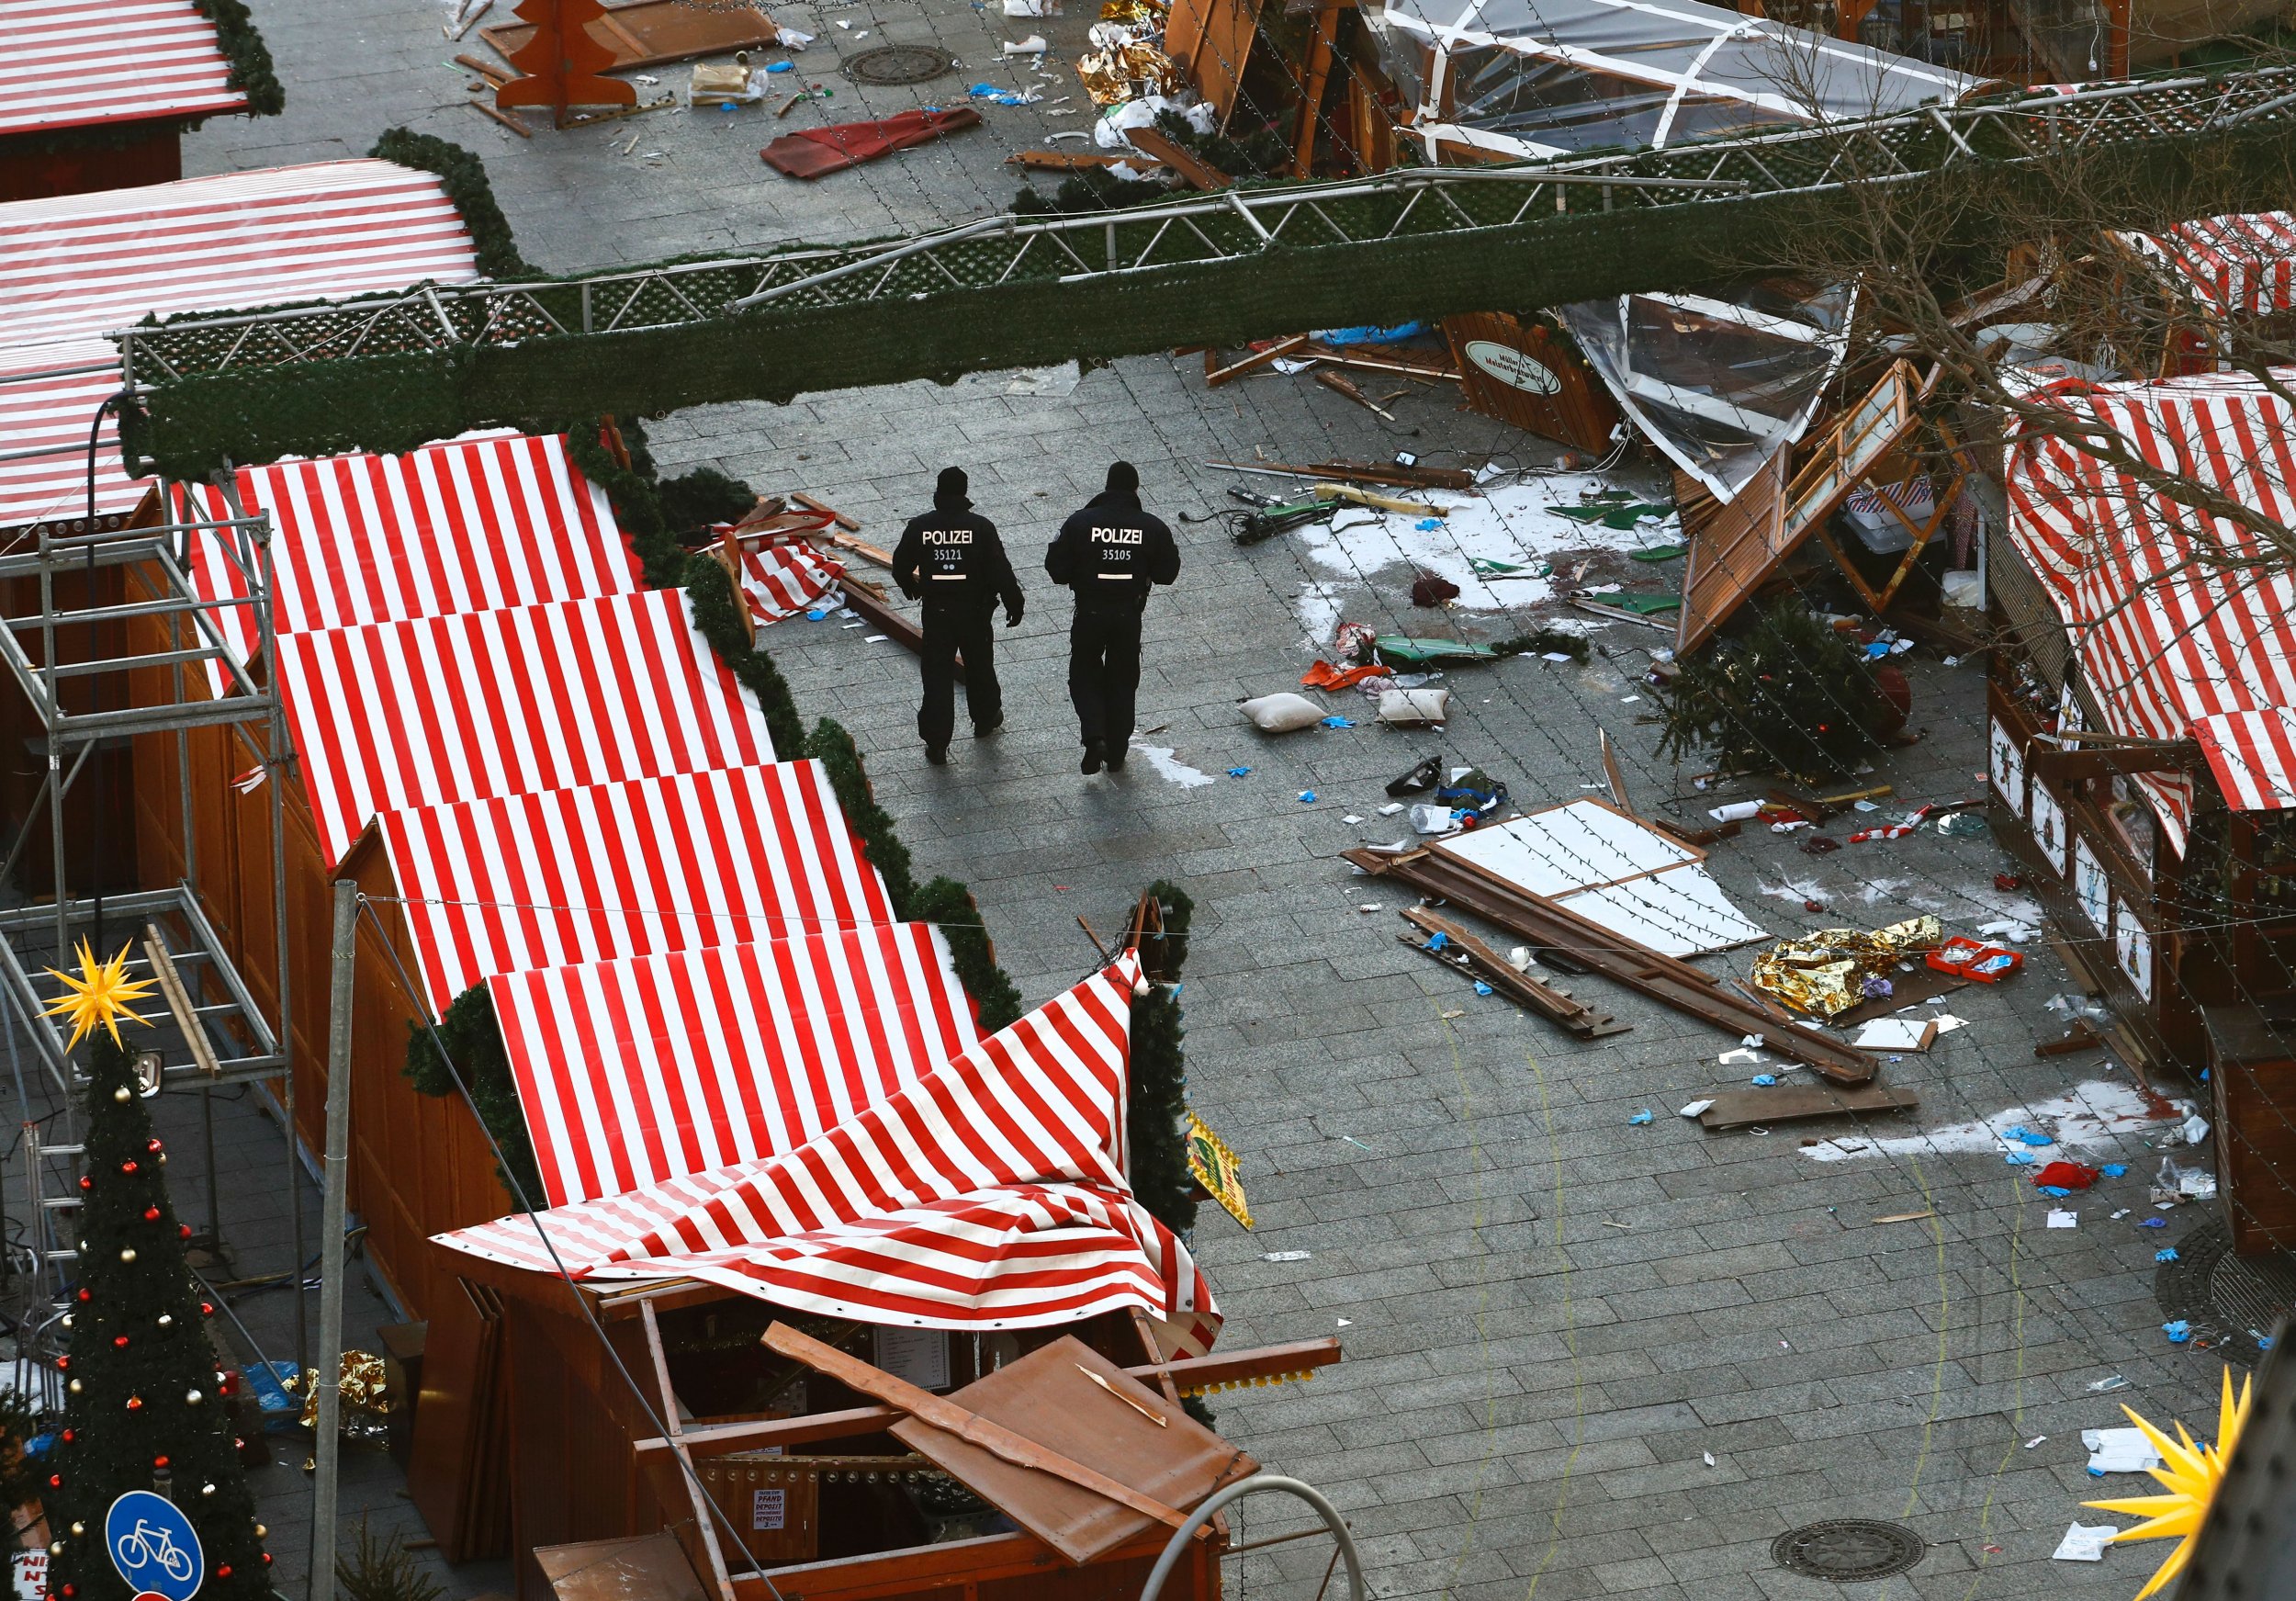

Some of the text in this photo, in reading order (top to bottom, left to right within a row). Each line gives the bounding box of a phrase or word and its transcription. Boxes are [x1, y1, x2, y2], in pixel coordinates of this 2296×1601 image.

[922, 530, 973, 545] POLIZEI
[1090, 527, 1142, 545] POLIZEI
[934, 549, 962, 560] 35121
[1102, 549, 1131, 560] 35105
